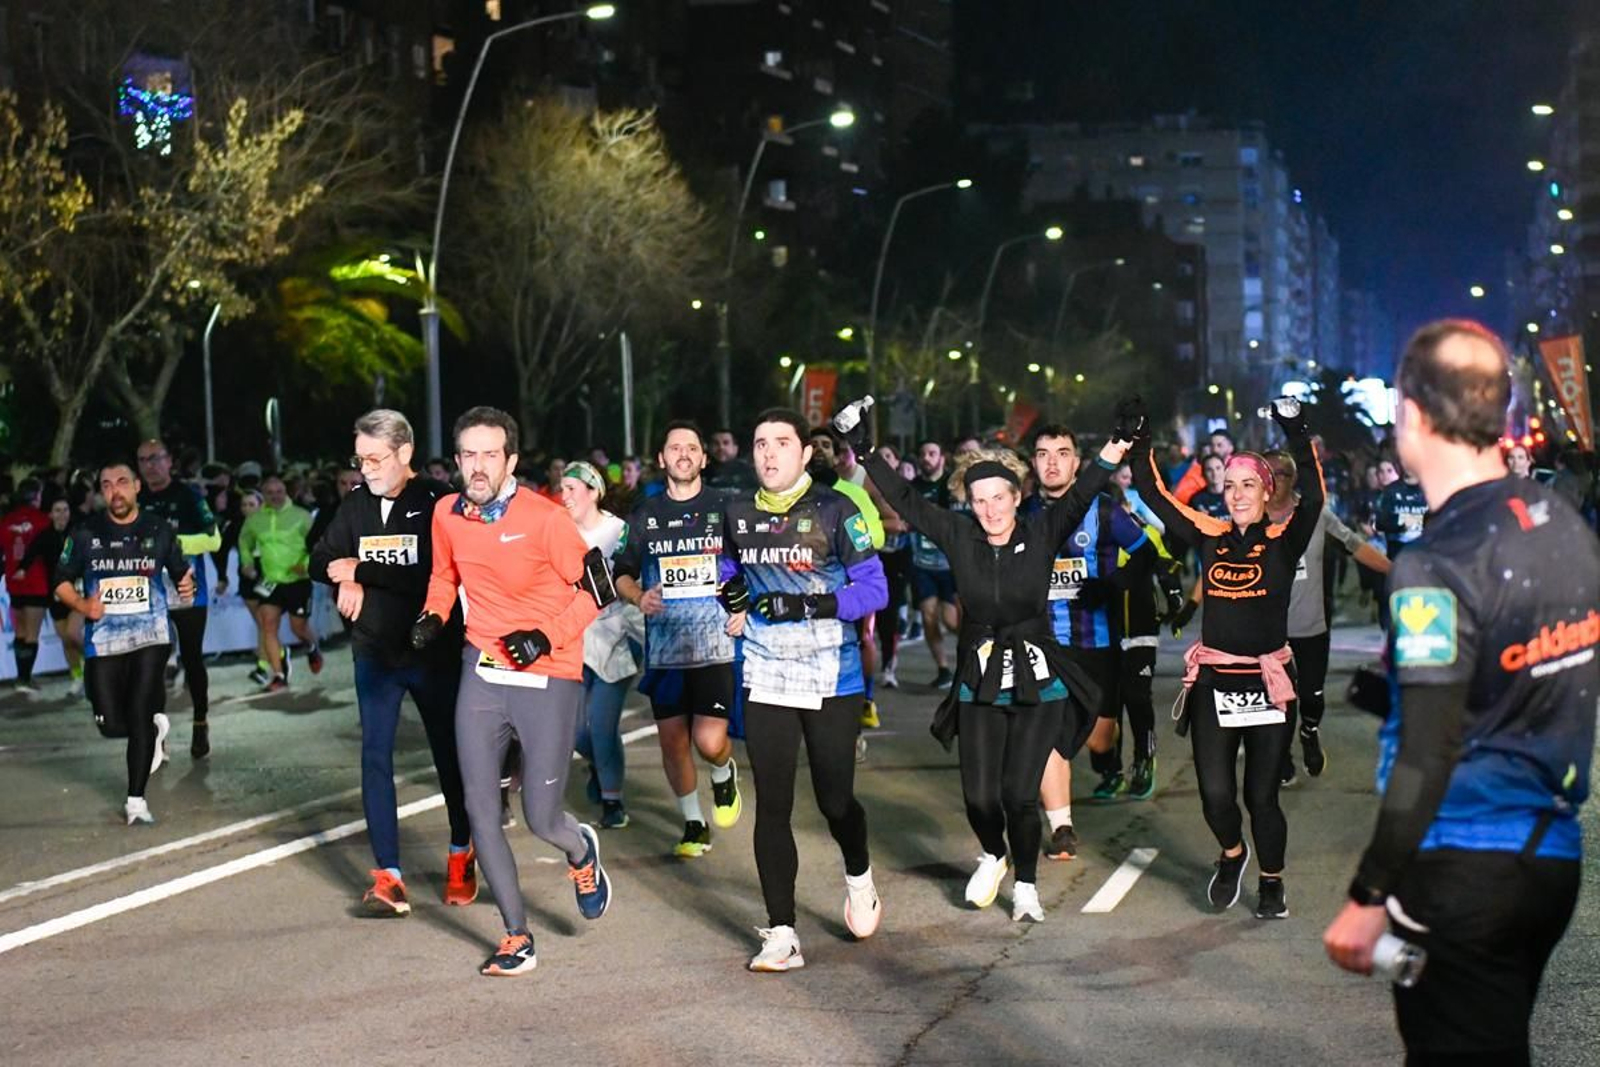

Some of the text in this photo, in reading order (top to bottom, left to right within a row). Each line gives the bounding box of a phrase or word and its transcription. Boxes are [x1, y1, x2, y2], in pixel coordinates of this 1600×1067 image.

[648, 540, 673, 555] SAN
[676, 533, 723, 552] ANTÓN
[365, 549, 410, 565] 5551
[760, 543, 813, 564] ANTÓN
[91, 556, 156, 571] SAN ANTÓN
[104, 586, 145, 600] 4628
